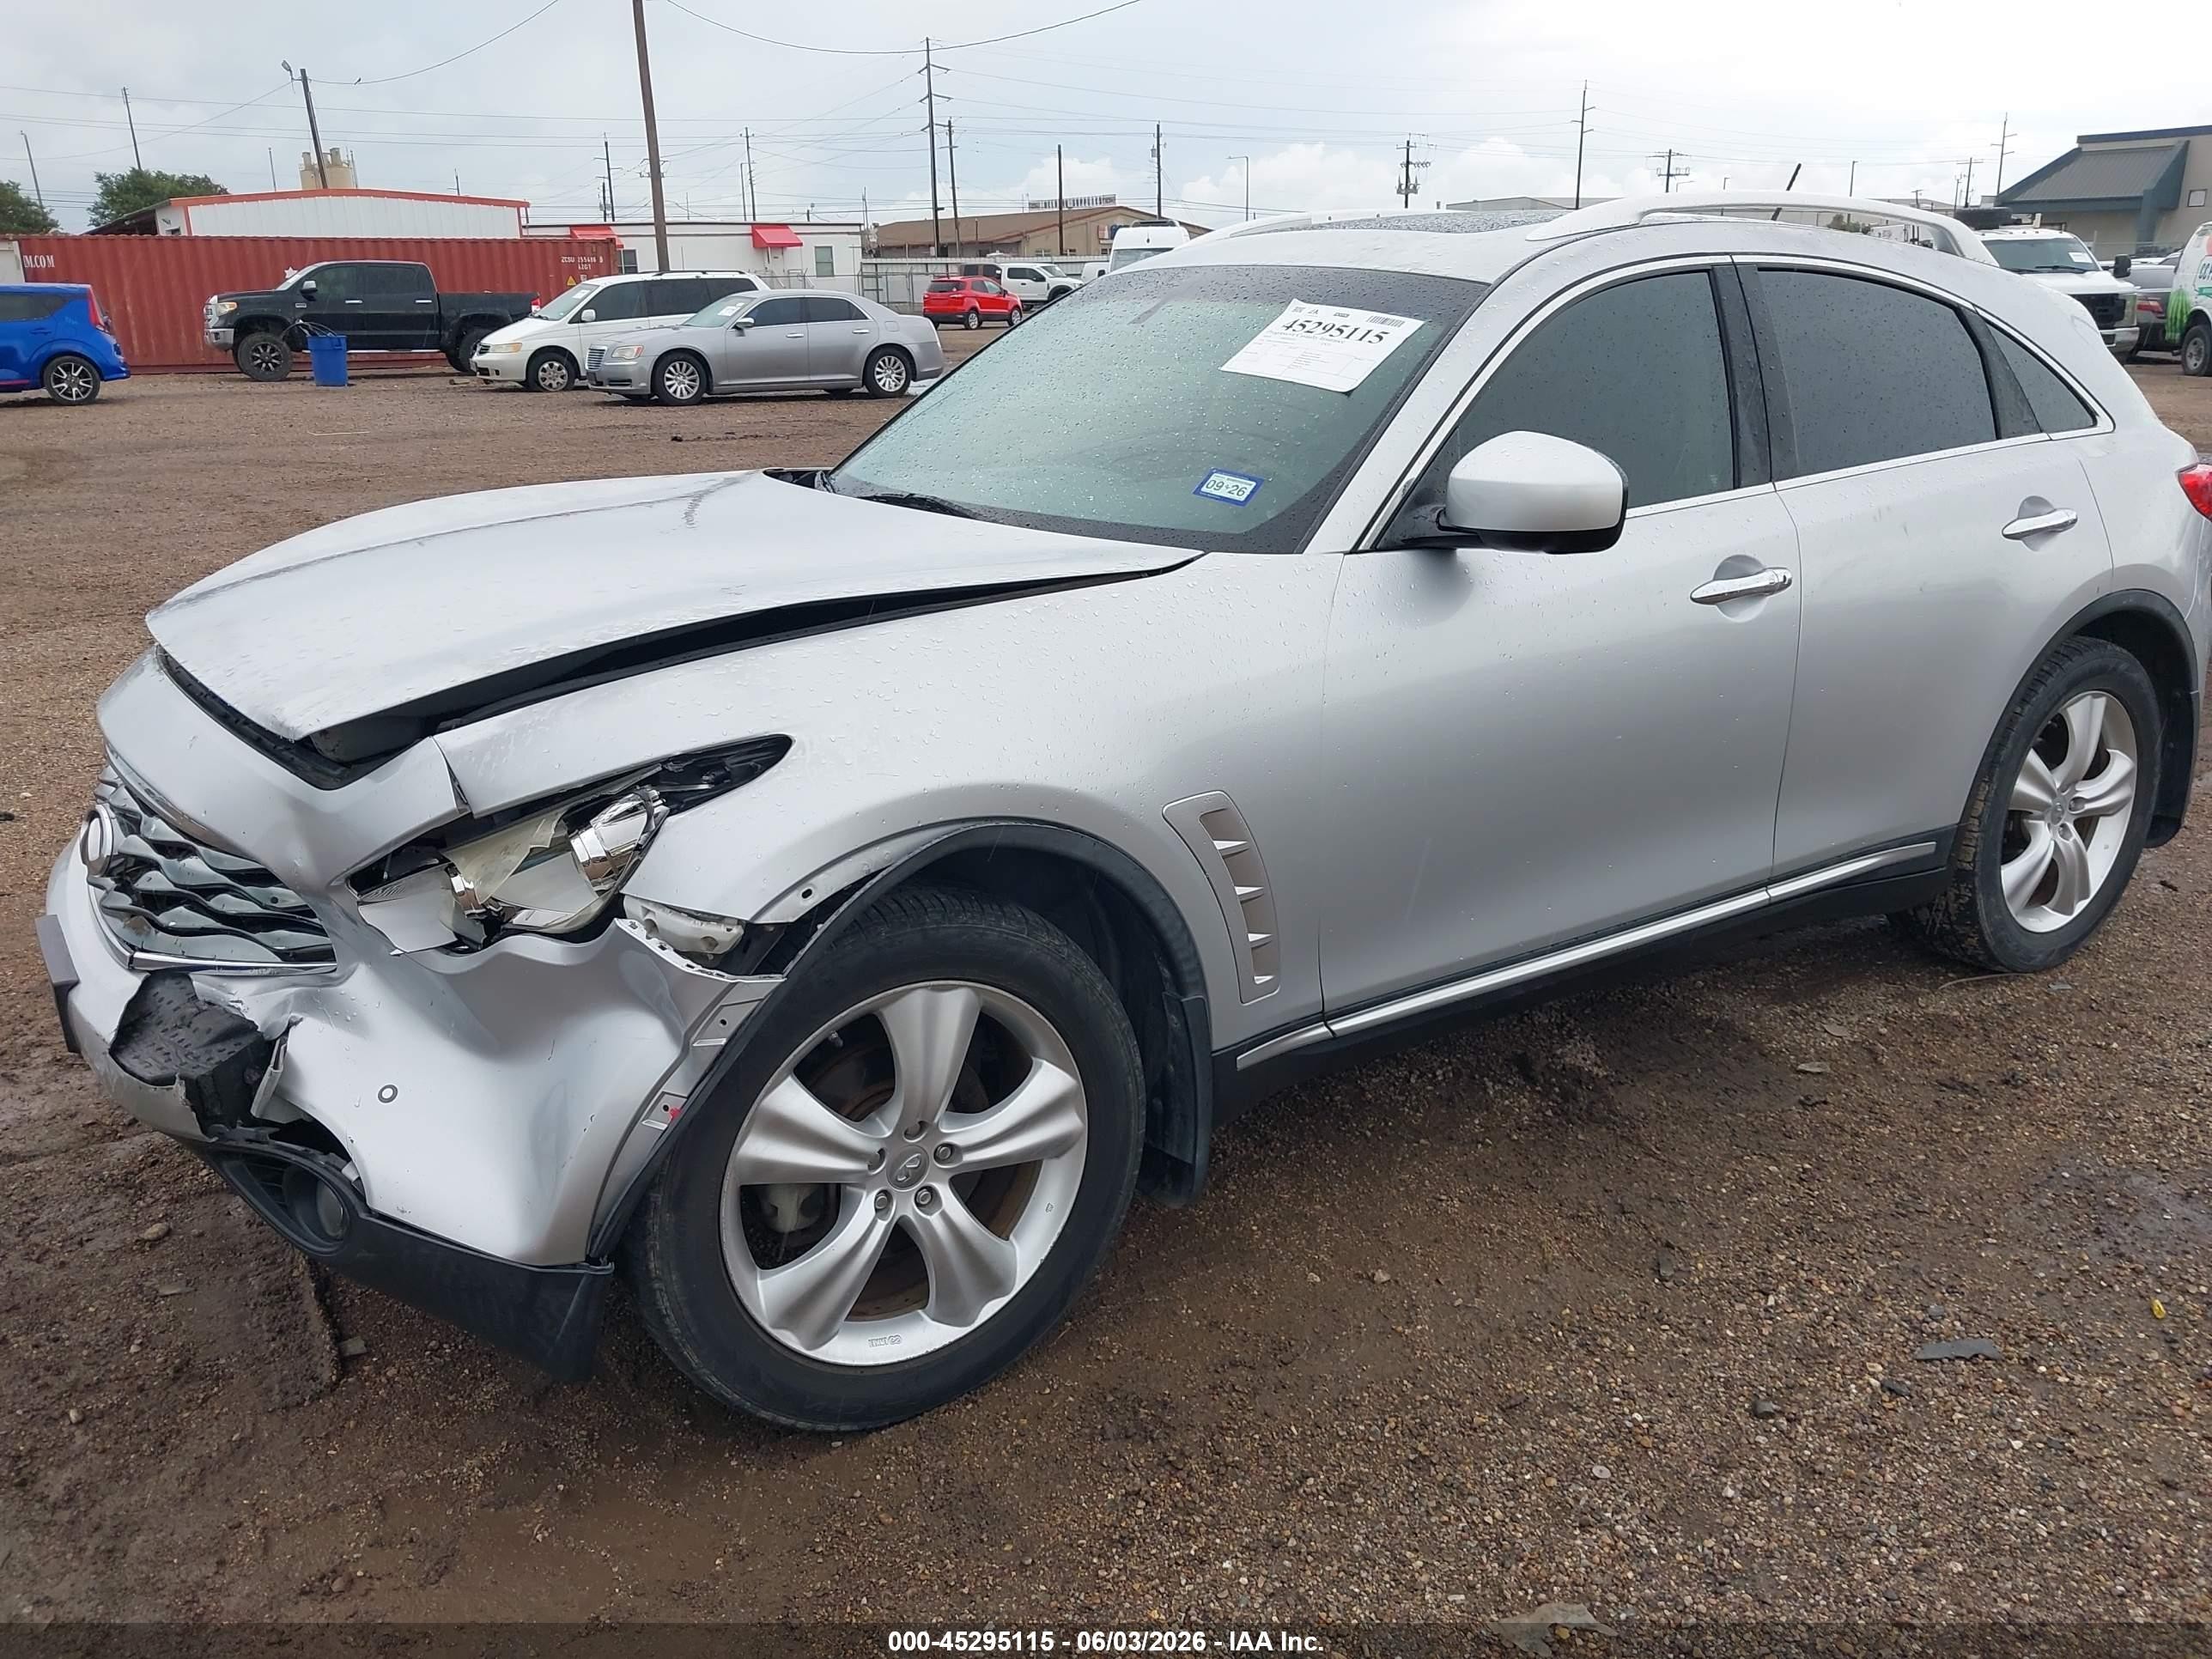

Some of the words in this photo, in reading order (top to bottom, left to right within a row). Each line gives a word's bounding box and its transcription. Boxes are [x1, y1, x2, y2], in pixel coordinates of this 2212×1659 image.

[1282, 318, 1391, 344] 45295115
[1206, 479, 1224, 491] 09
[1227, 484, 1248, 497] 26
